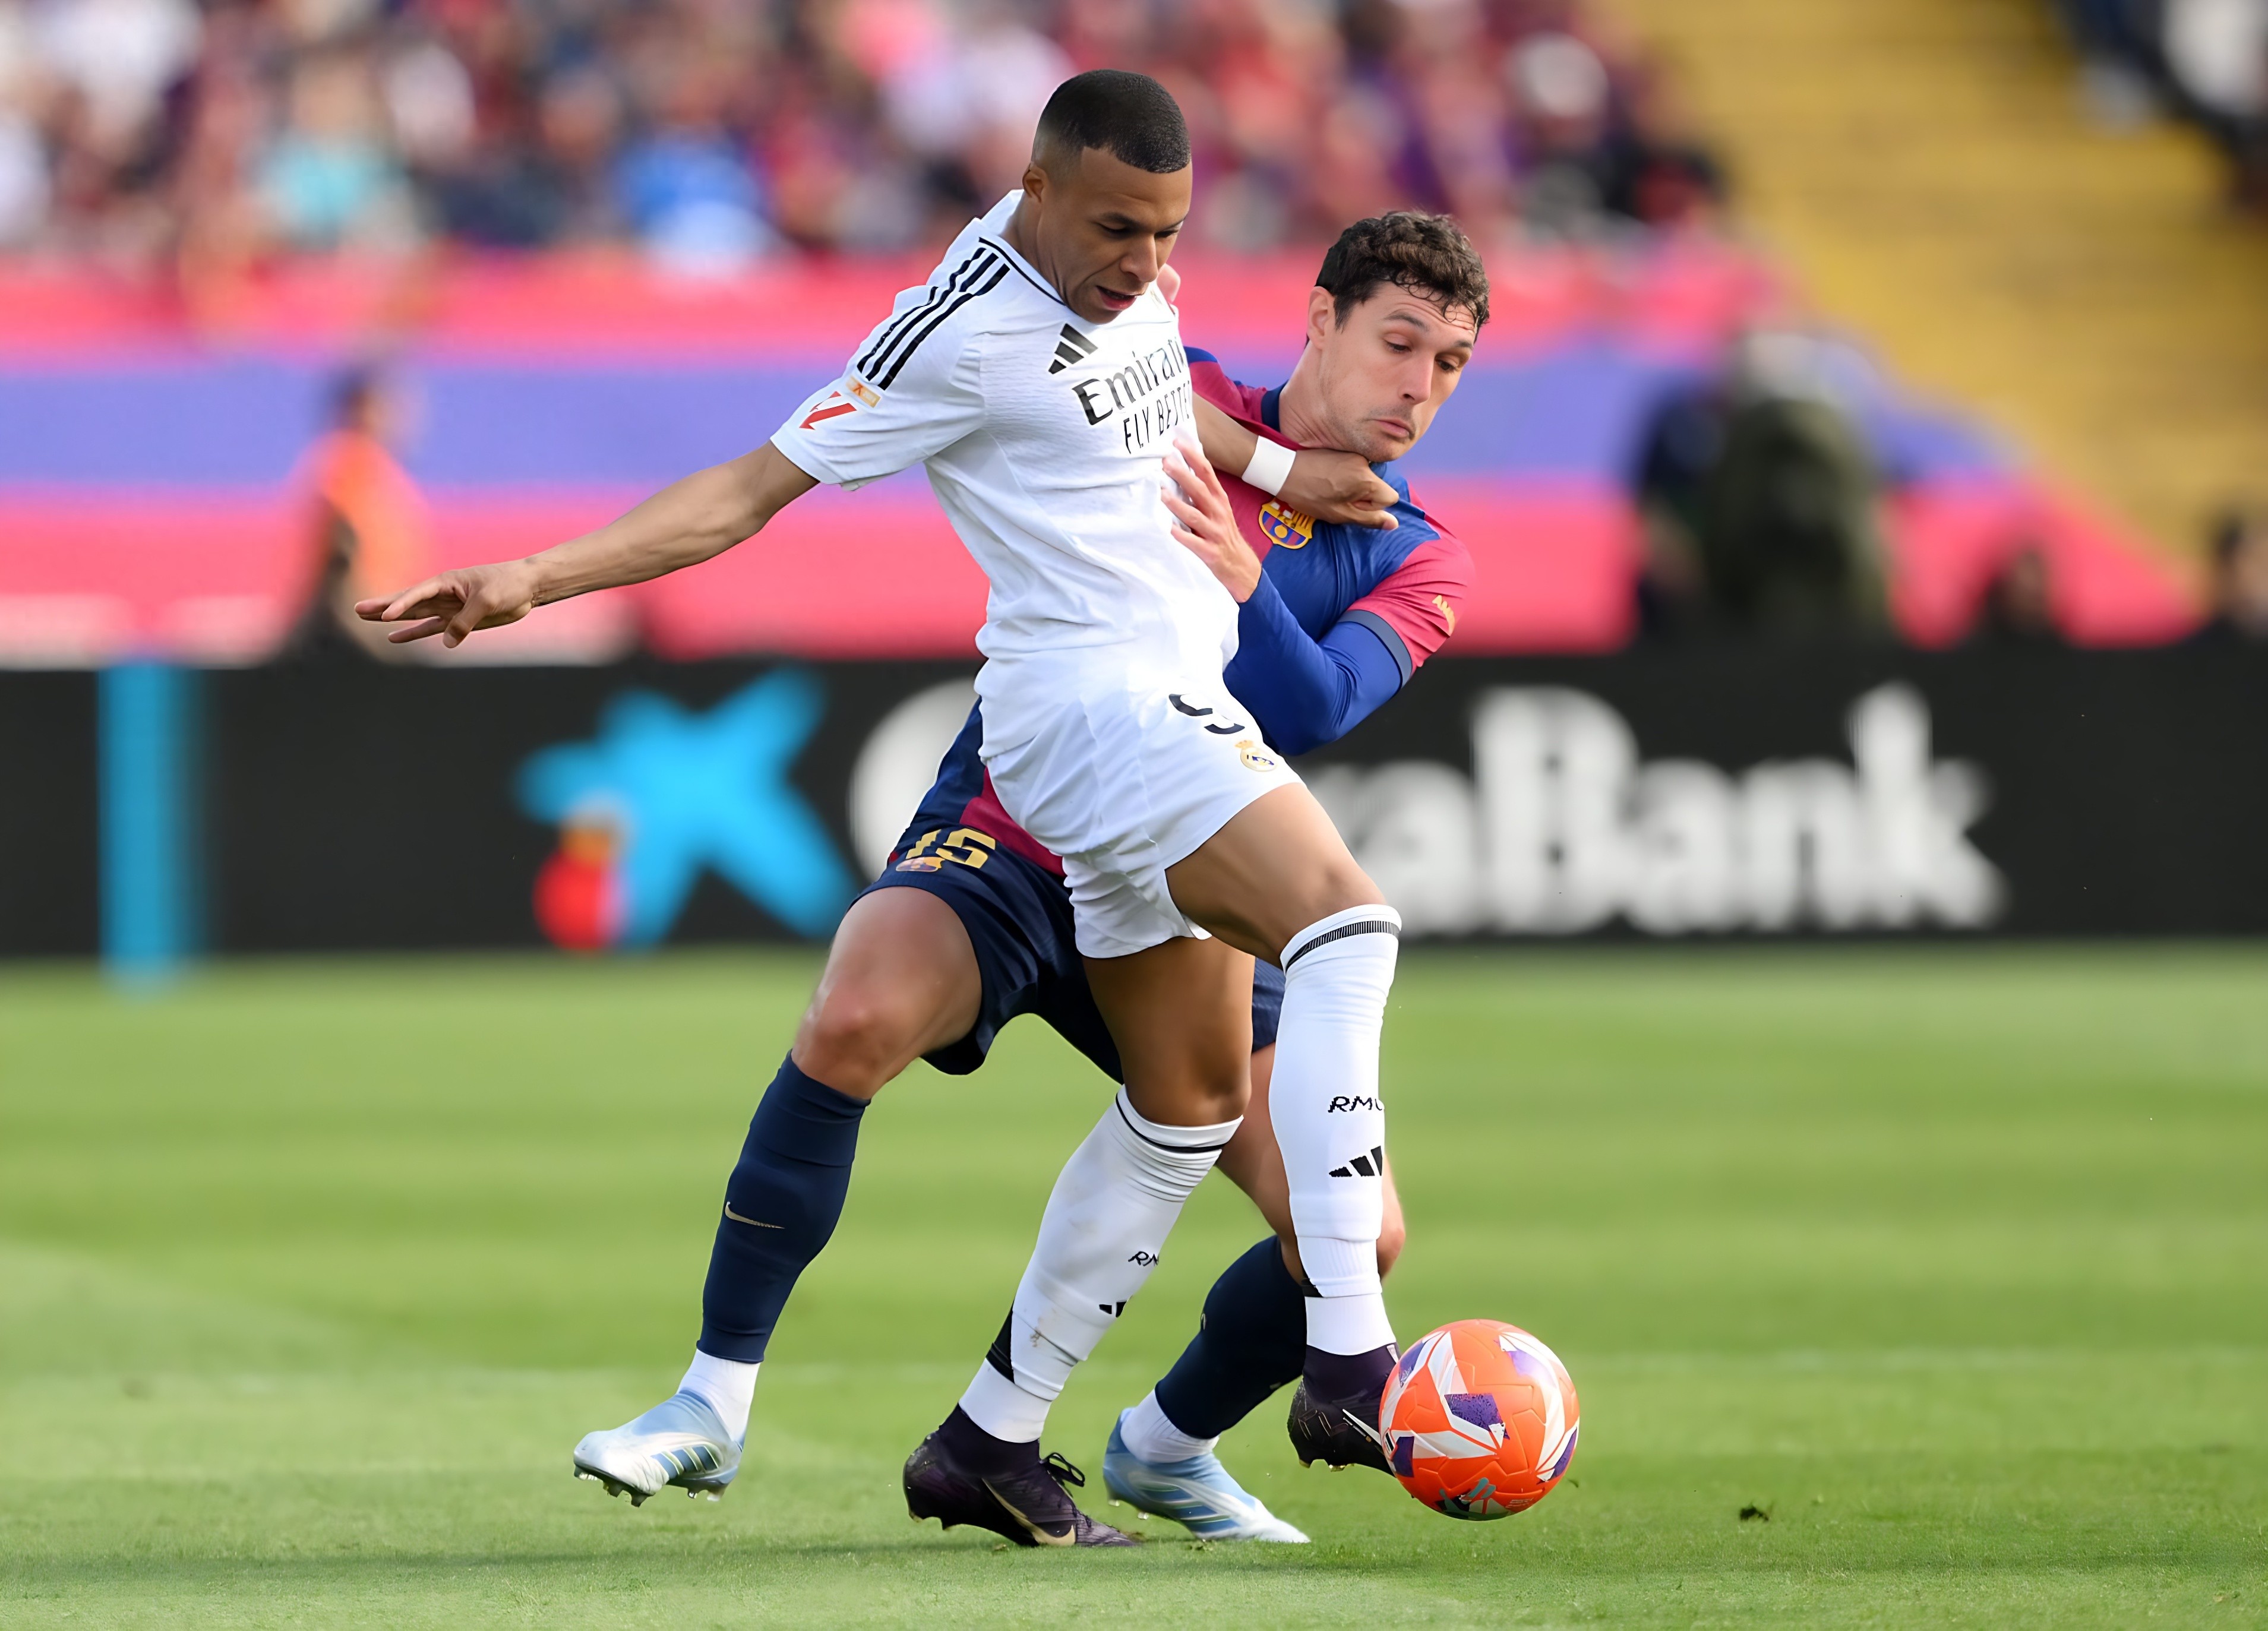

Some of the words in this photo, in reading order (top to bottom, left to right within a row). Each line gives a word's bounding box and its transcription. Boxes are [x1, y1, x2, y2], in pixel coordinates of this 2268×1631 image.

[1071, 336, 1187, 426] Emirat
[1123, 406, 1150, 454] FLY
[1156, 380, 1191, 437] BETTE
[905, 828, 996, 869] 15
